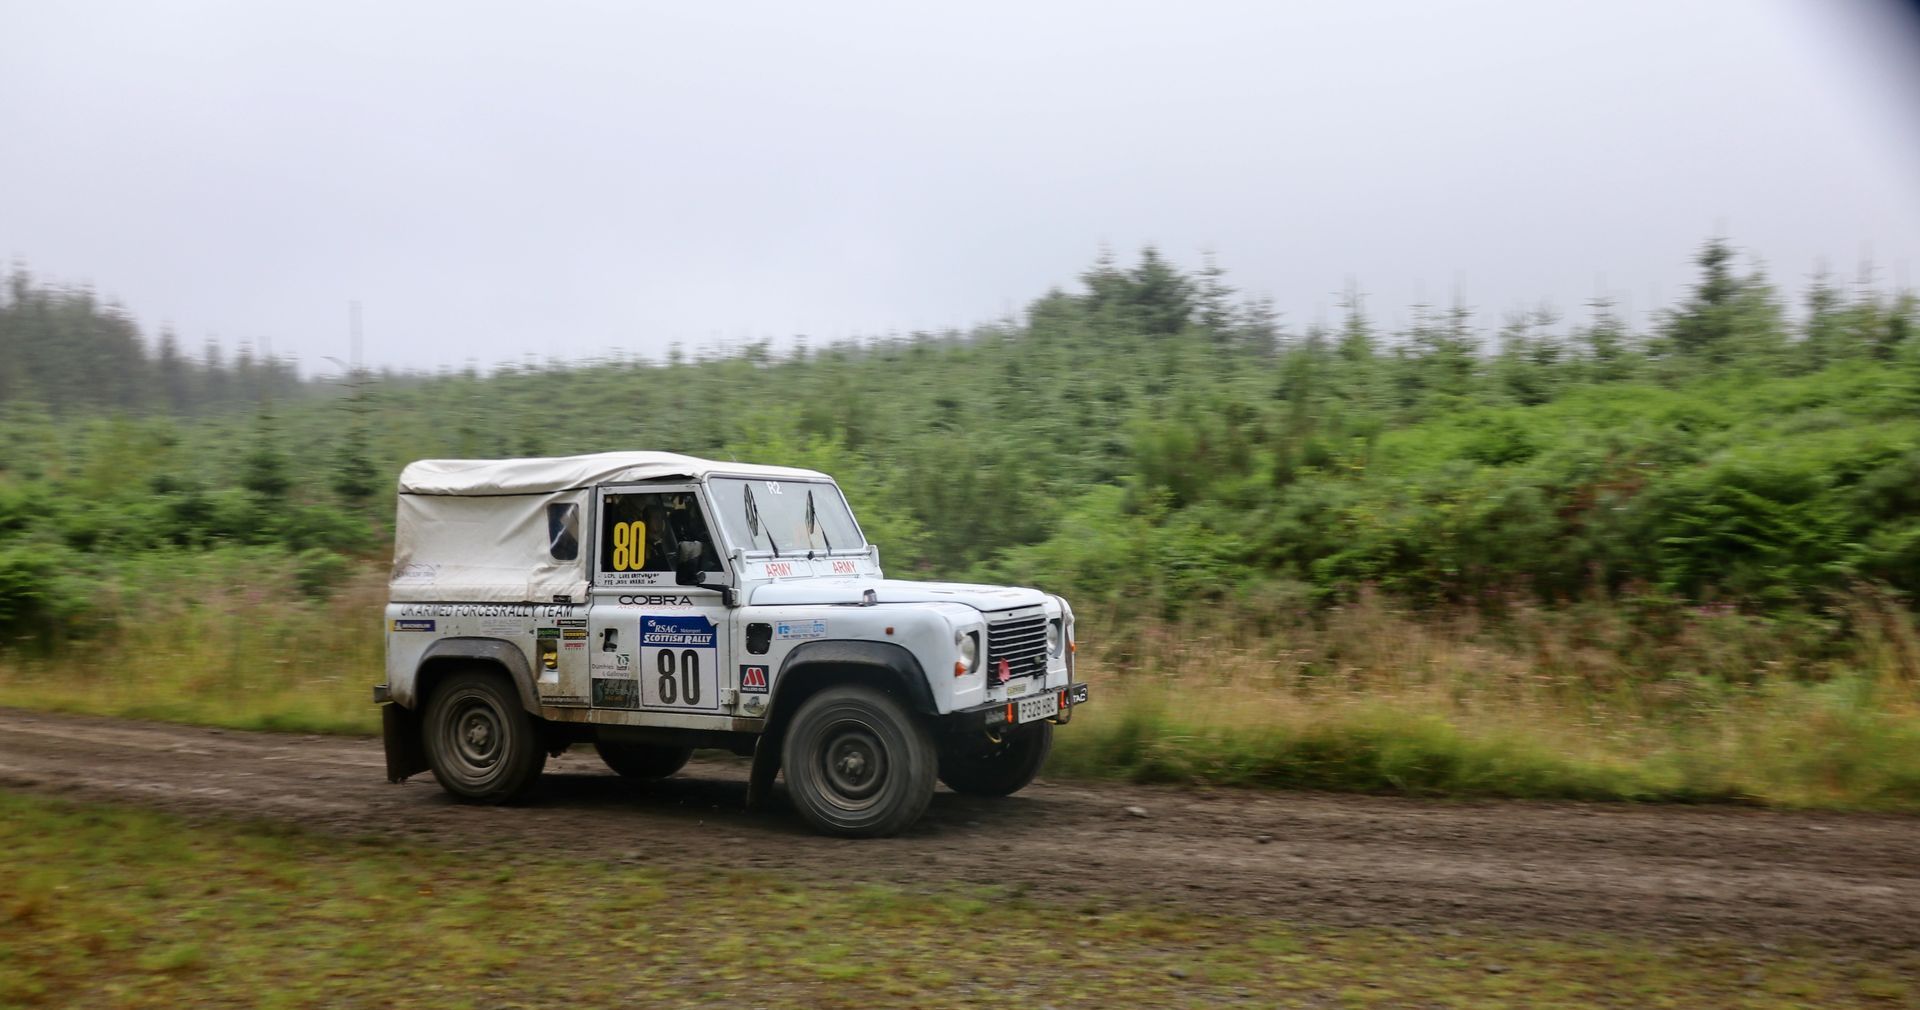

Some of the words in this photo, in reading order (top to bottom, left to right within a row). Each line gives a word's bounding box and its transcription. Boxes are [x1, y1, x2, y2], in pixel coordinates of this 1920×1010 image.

[766, 481, 782, 494] R2
[613, 520, 646, 571] 80
[765, 562, 793, 577] ARMY
[832, 560, 857, 574] ARMY
[619, 595, 693, 606] COBRA
[454, 605, 500, 618] FORCES
[499, 605, 538, 618] RALLY
[541, 605, 574, 617] TEAM
[654, 624, 678, 634] RSAC
[643, 634, 683, 643] SCOTTISH
[684, 635, 712, 644] RALLY
[657, 648, 700, 706] 80
